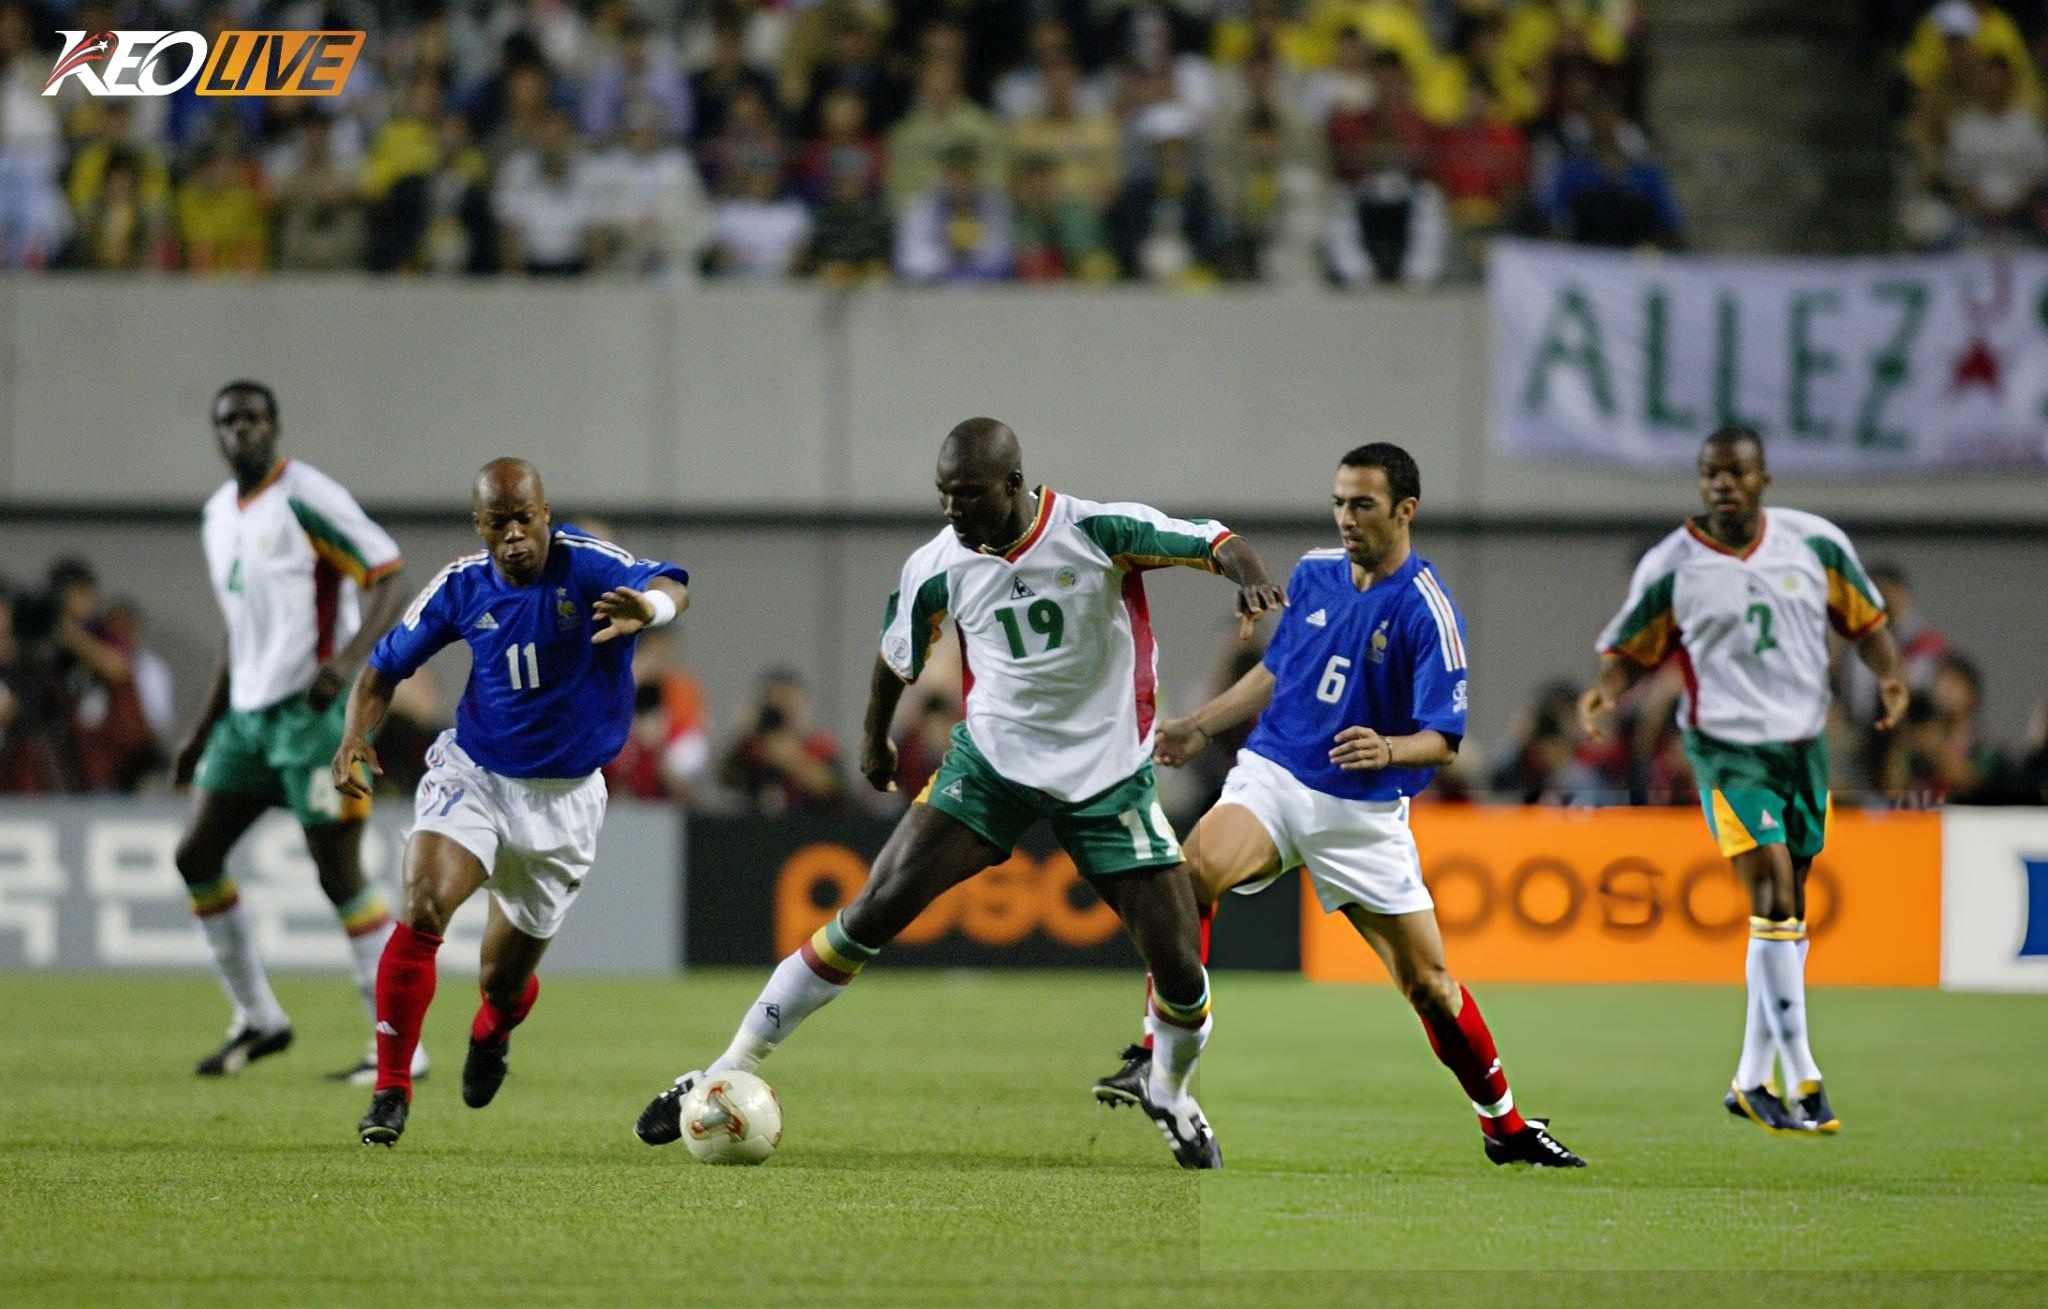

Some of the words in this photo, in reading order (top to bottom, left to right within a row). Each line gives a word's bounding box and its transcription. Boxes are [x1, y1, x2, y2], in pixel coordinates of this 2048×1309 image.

[1522, 277, 1930, 450] ALLEZ
[994, 598, 1064, 660] 19
[1746, 602, 1777, 655] 2
[505, 642, 540, 690] 11
[1316, 655, 1351, 703] 6
